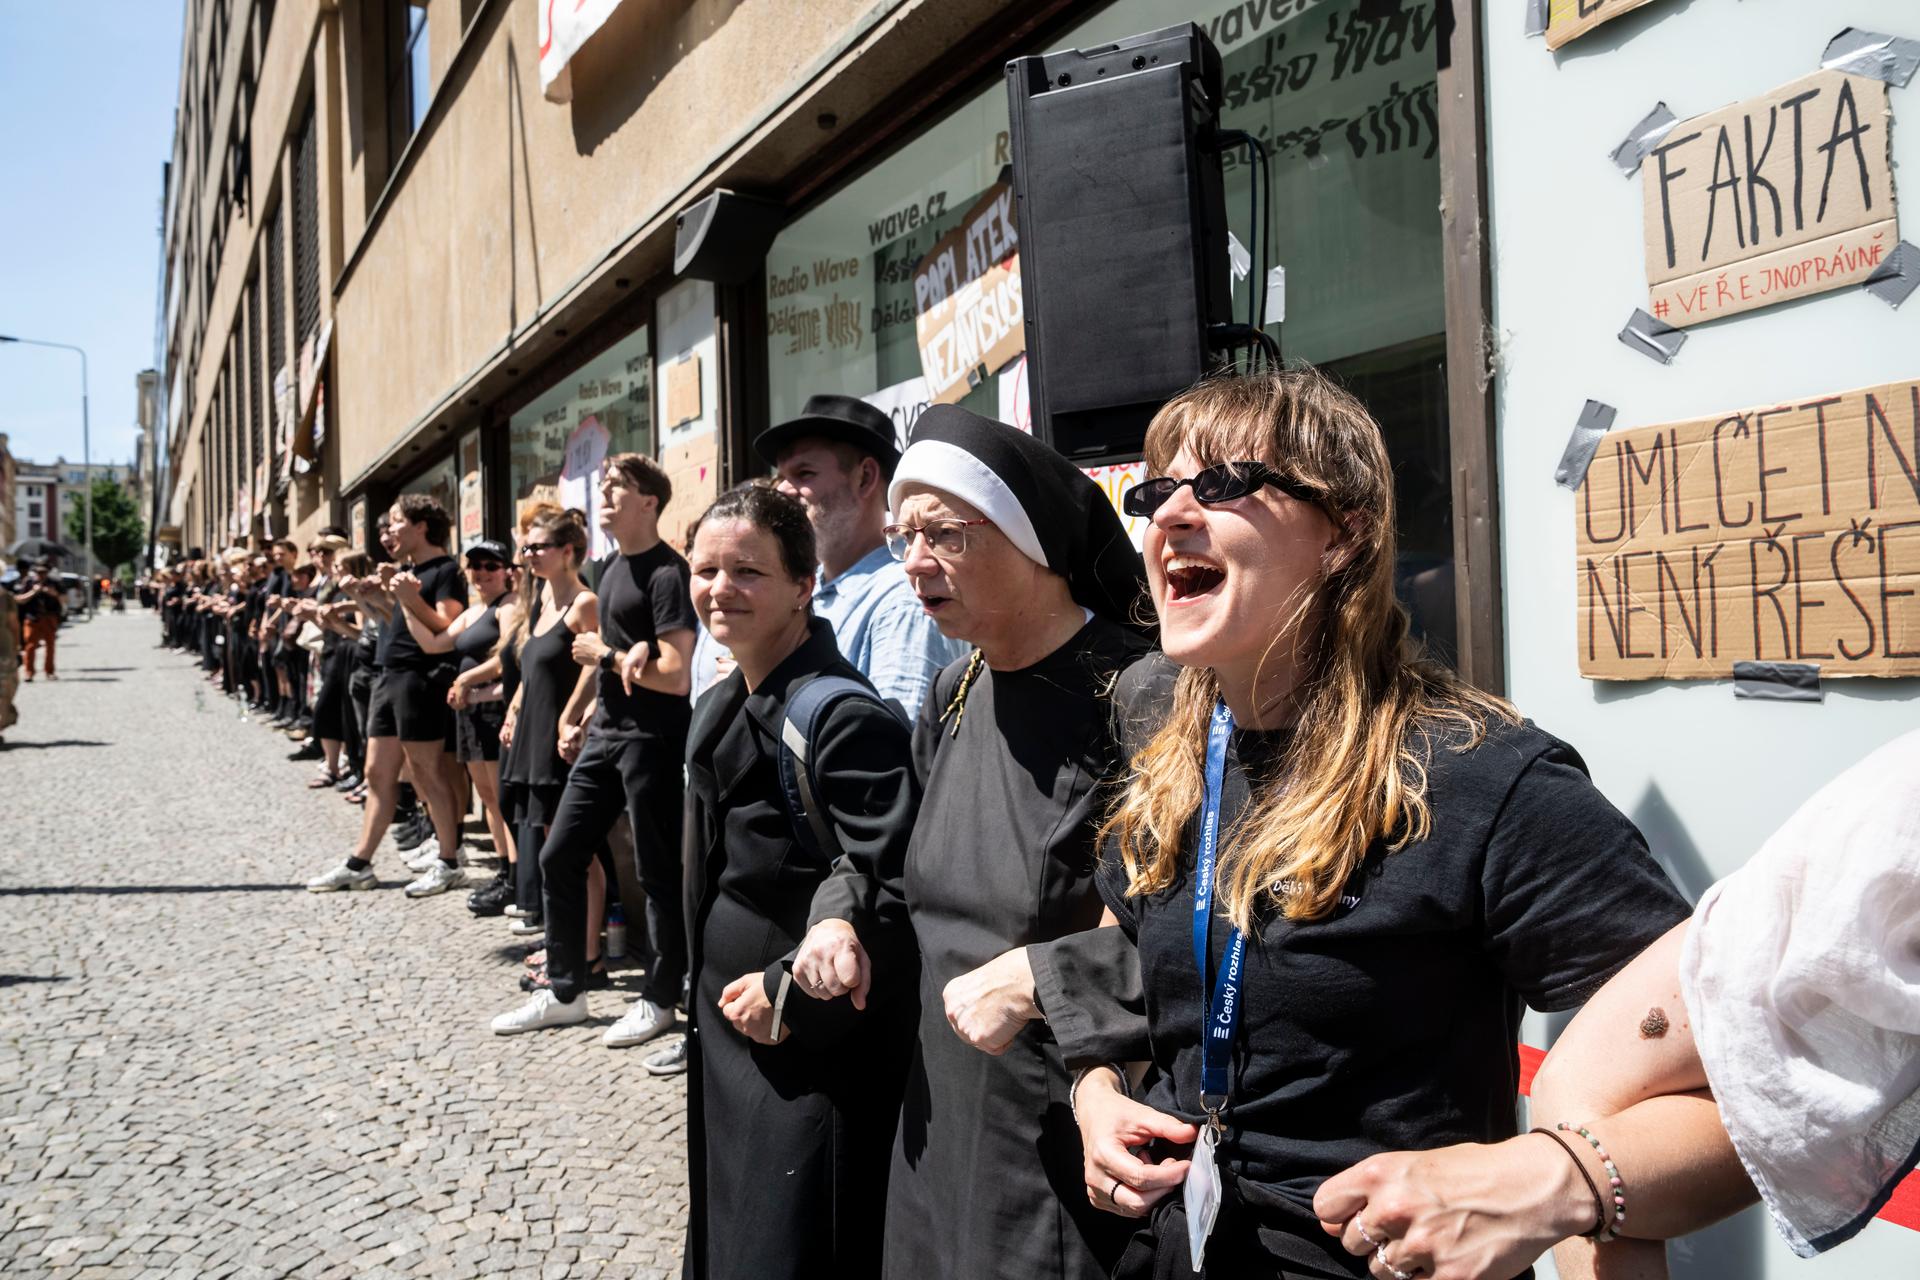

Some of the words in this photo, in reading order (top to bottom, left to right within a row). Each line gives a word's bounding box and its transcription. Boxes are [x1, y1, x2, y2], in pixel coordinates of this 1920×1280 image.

[1651, 78, 1872, 269] FAKTA
[868, 191, 947, 246] wave.cz
[768, 265, 809, 300] Radio
[813, 257, 859, 288] Wave
[914, 185, 1018, 334] POPLATEK
[1585, 396, 1843, 544] UMLČET
[1587, 542, 1726, 662] NENÍ
[1749, 516, 1920, 662] ŘEŠE
[1203, 810, 1216, 857] rozhlas
[1197, 856, 1213, 897] Český
[1225, 932, 1244, 983] rozhlas
[1216, 982, 1238, 1025] Český
